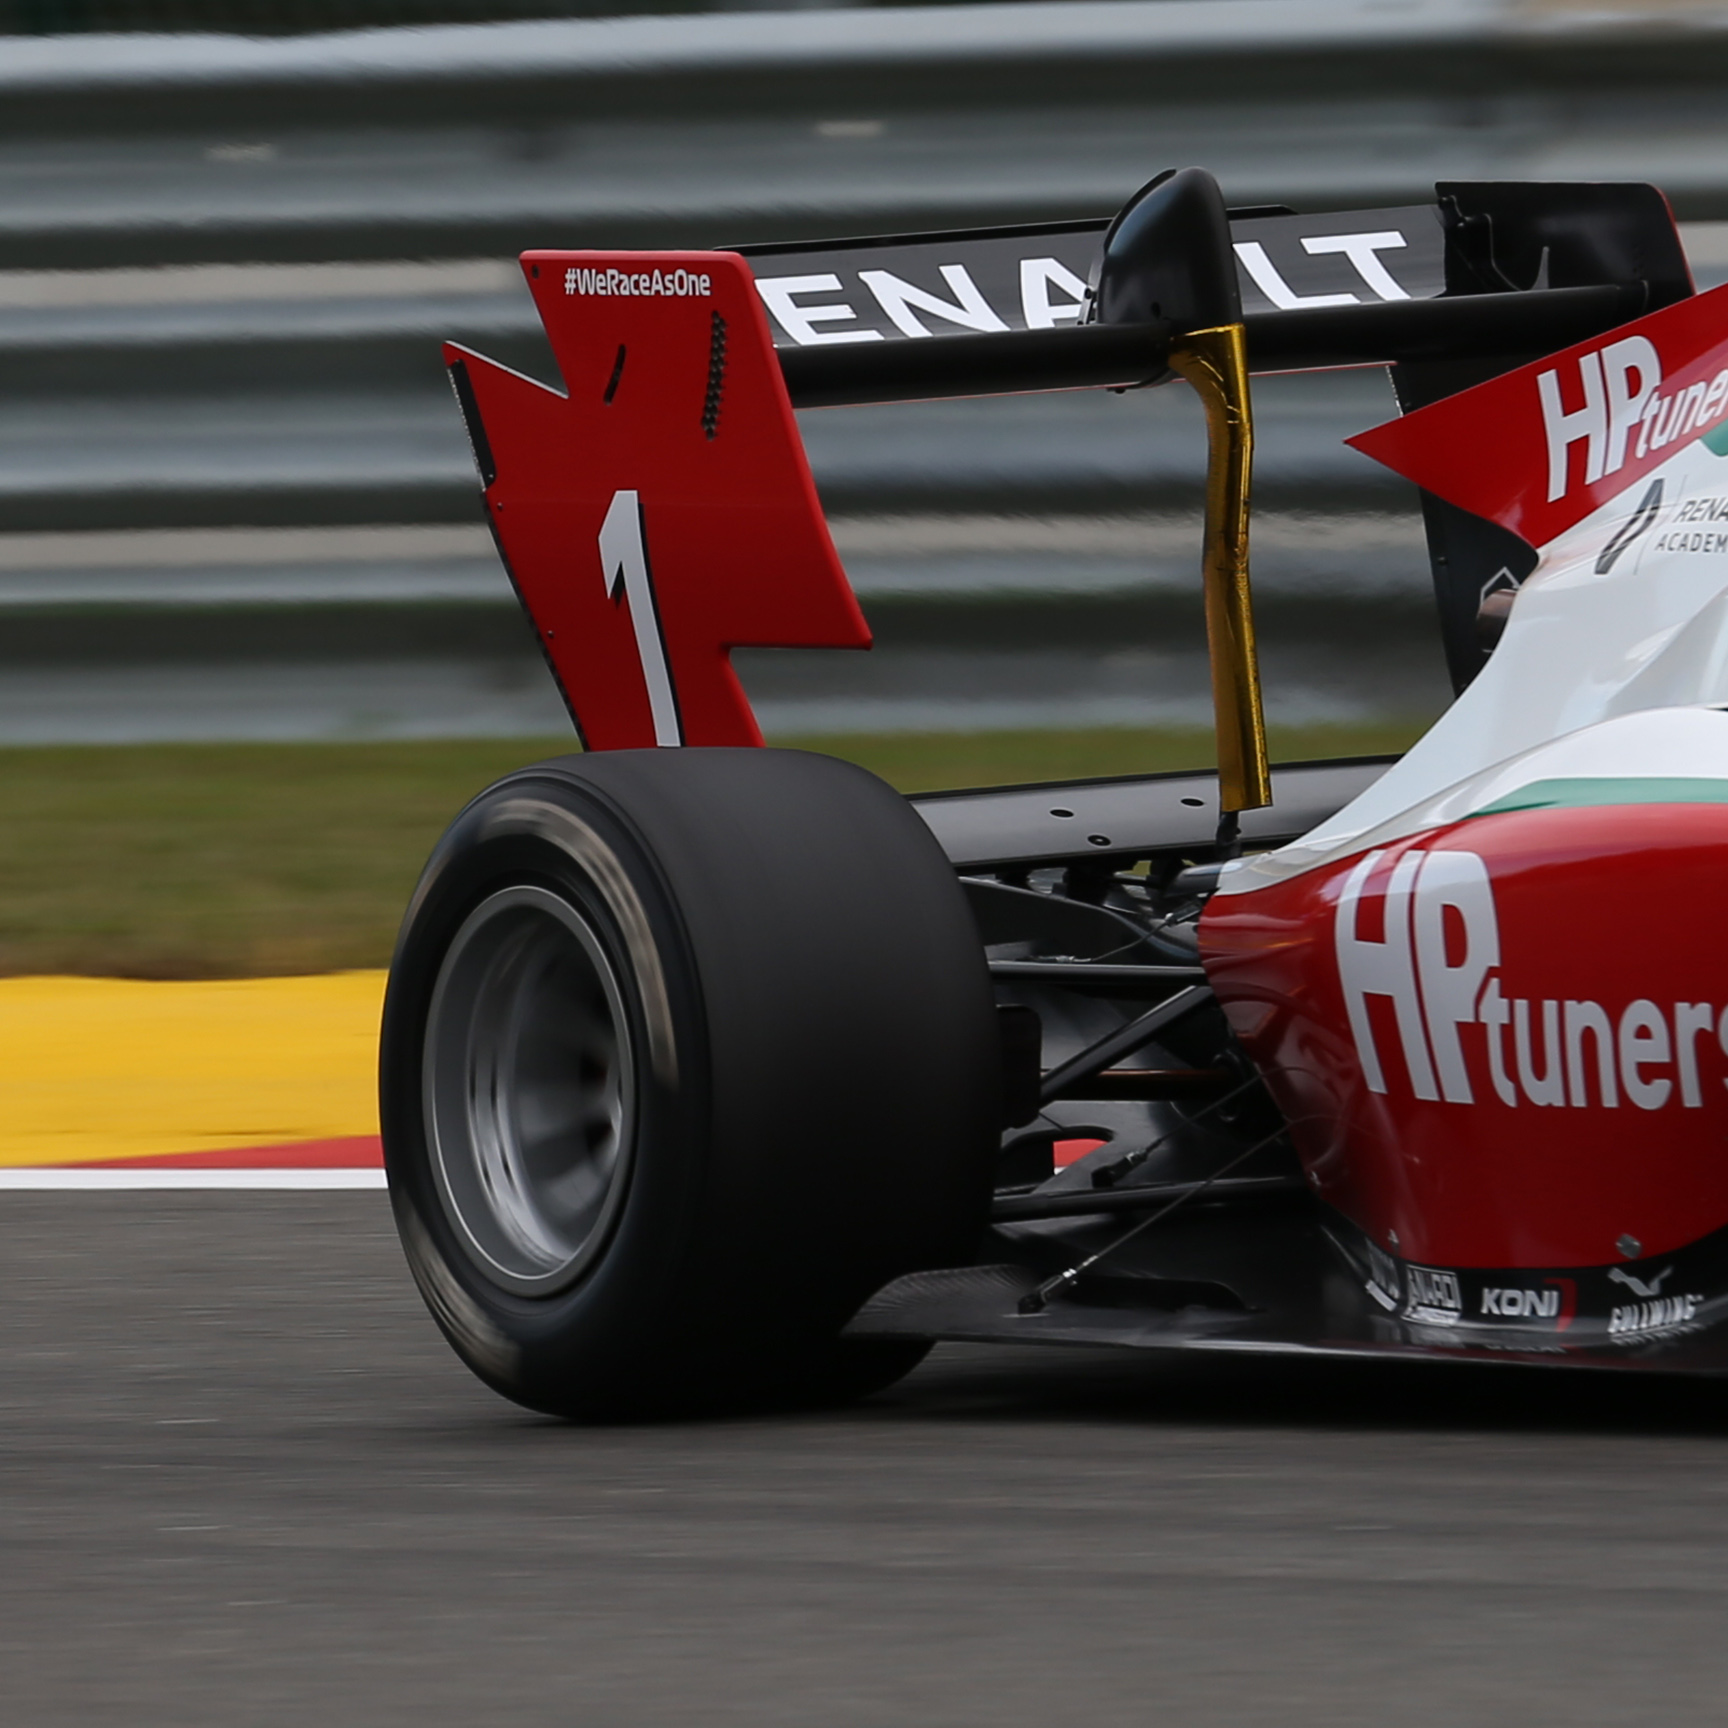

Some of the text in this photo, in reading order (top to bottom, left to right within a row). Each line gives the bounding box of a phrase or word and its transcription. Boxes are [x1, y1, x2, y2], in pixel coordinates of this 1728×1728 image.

[565, 268, 711, 297] #WeRaceAsOne
[755, 231, 1411, 346] ENALT
[598, 491, 683, 747] 1
[1480, 1288, 1560, 1317] KONI
